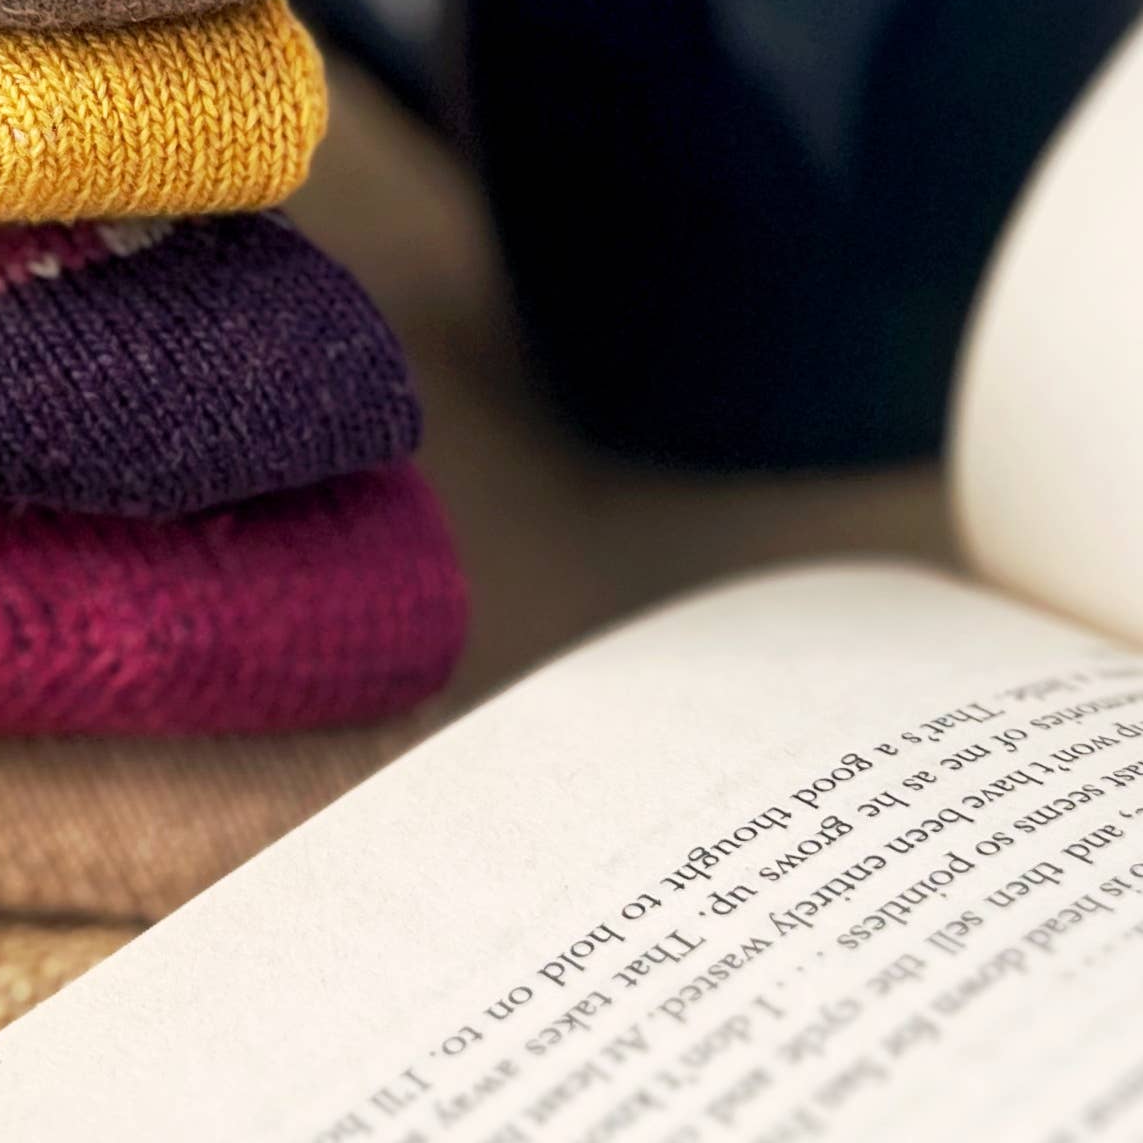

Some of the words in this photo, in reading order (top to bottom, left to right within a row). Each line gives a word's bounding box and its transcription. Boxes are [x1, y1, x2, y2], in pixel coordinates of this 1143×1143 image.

[900, 703, 1006, 744] That's
[990, 728, 1028, 752] of
[874, 743, 898, 756] a
[940, 744, 992, 770] me
[1028, 735, 1120, 773] won't
[790, 753, 873, 809] good
[902, 770, 937, 791] as
[962, 769, 1044, 809] have
[1100, 761, 1143, 787] ast
[857, 791, 911, 817] he
[1013, 784, 1105, 833] seems
[660, 807, 792, 892] thought
[759, 815, 853, 882] grows
[884, 808, 975, 854] been
[975, 831, 1014, 857] so
[1061, 824, 1124, 865] and
[698, 884, 758, 916] up.
[769, 855, 886, 937] entirely
[837, 851, 975, 949] pointless
[984, 862, 1064, 907] then
[1099, 876, 1143, 898] is
[621, 893, 662, 920] to
[1022, 894, 1115, 954] head
[925, 910, 984, 955] sell
[537, 922, 626, 987] hold
[611, 929, 707, 988] That
[866, 954, 926, 995] the
[647, 937, 773, 1024] wasted.
[483, 986, 533, 1020] on
[525, 991, 612, 1055] takes
[753, 996, 786, 1019] I
[429, 1026, 483, 1056] to.
